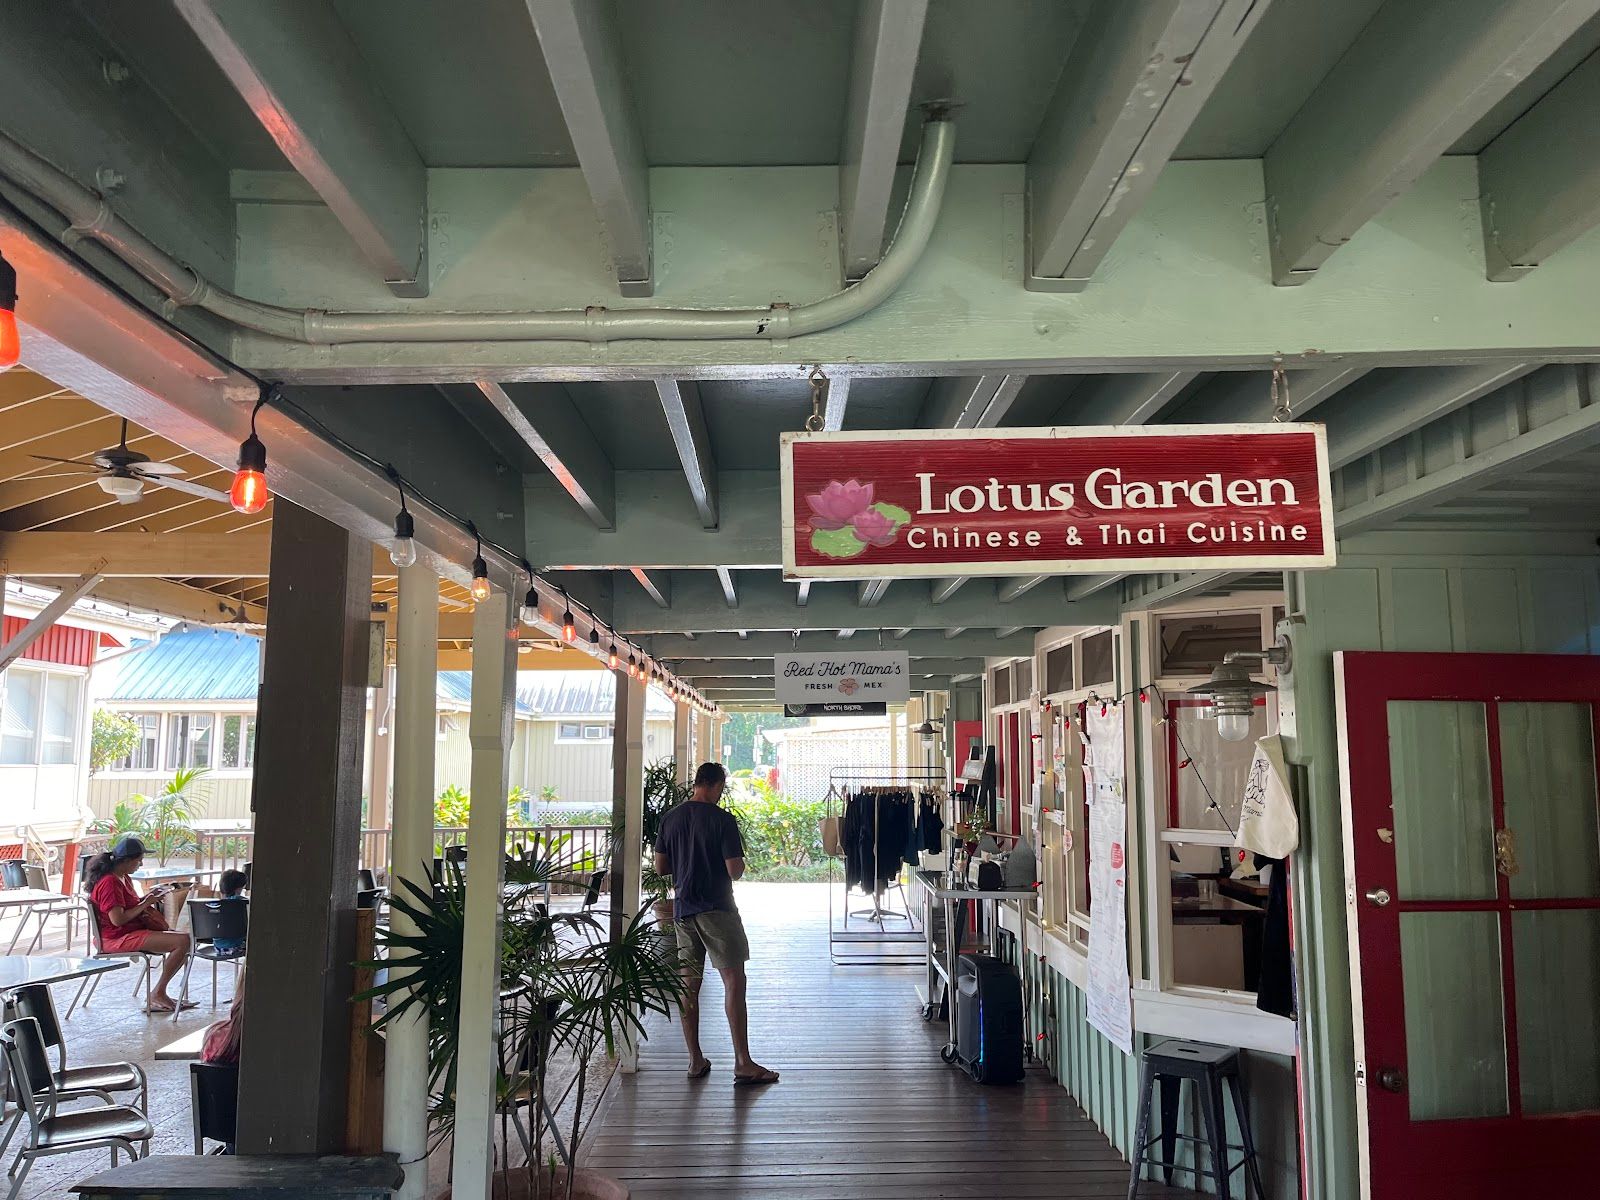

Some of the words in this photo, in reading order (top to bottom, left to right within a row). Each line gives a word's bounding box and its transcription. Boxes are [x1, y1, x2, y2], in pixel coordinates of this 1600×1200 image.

[915, 472, 1074, 514] Lotus
[1085, 467, 1299, 511] Garden
[907, 526, 1042, 548] Chinese
[1066, 526, 1083, 545] &
[1098, 523, 1166, 545] Thai
[1187, 520, 1308, 544] Cuisine
[784, 661, 815, 677] Red
[818, 661, 845, 677] Hot
[848, 660, 901, 676] Mama's
